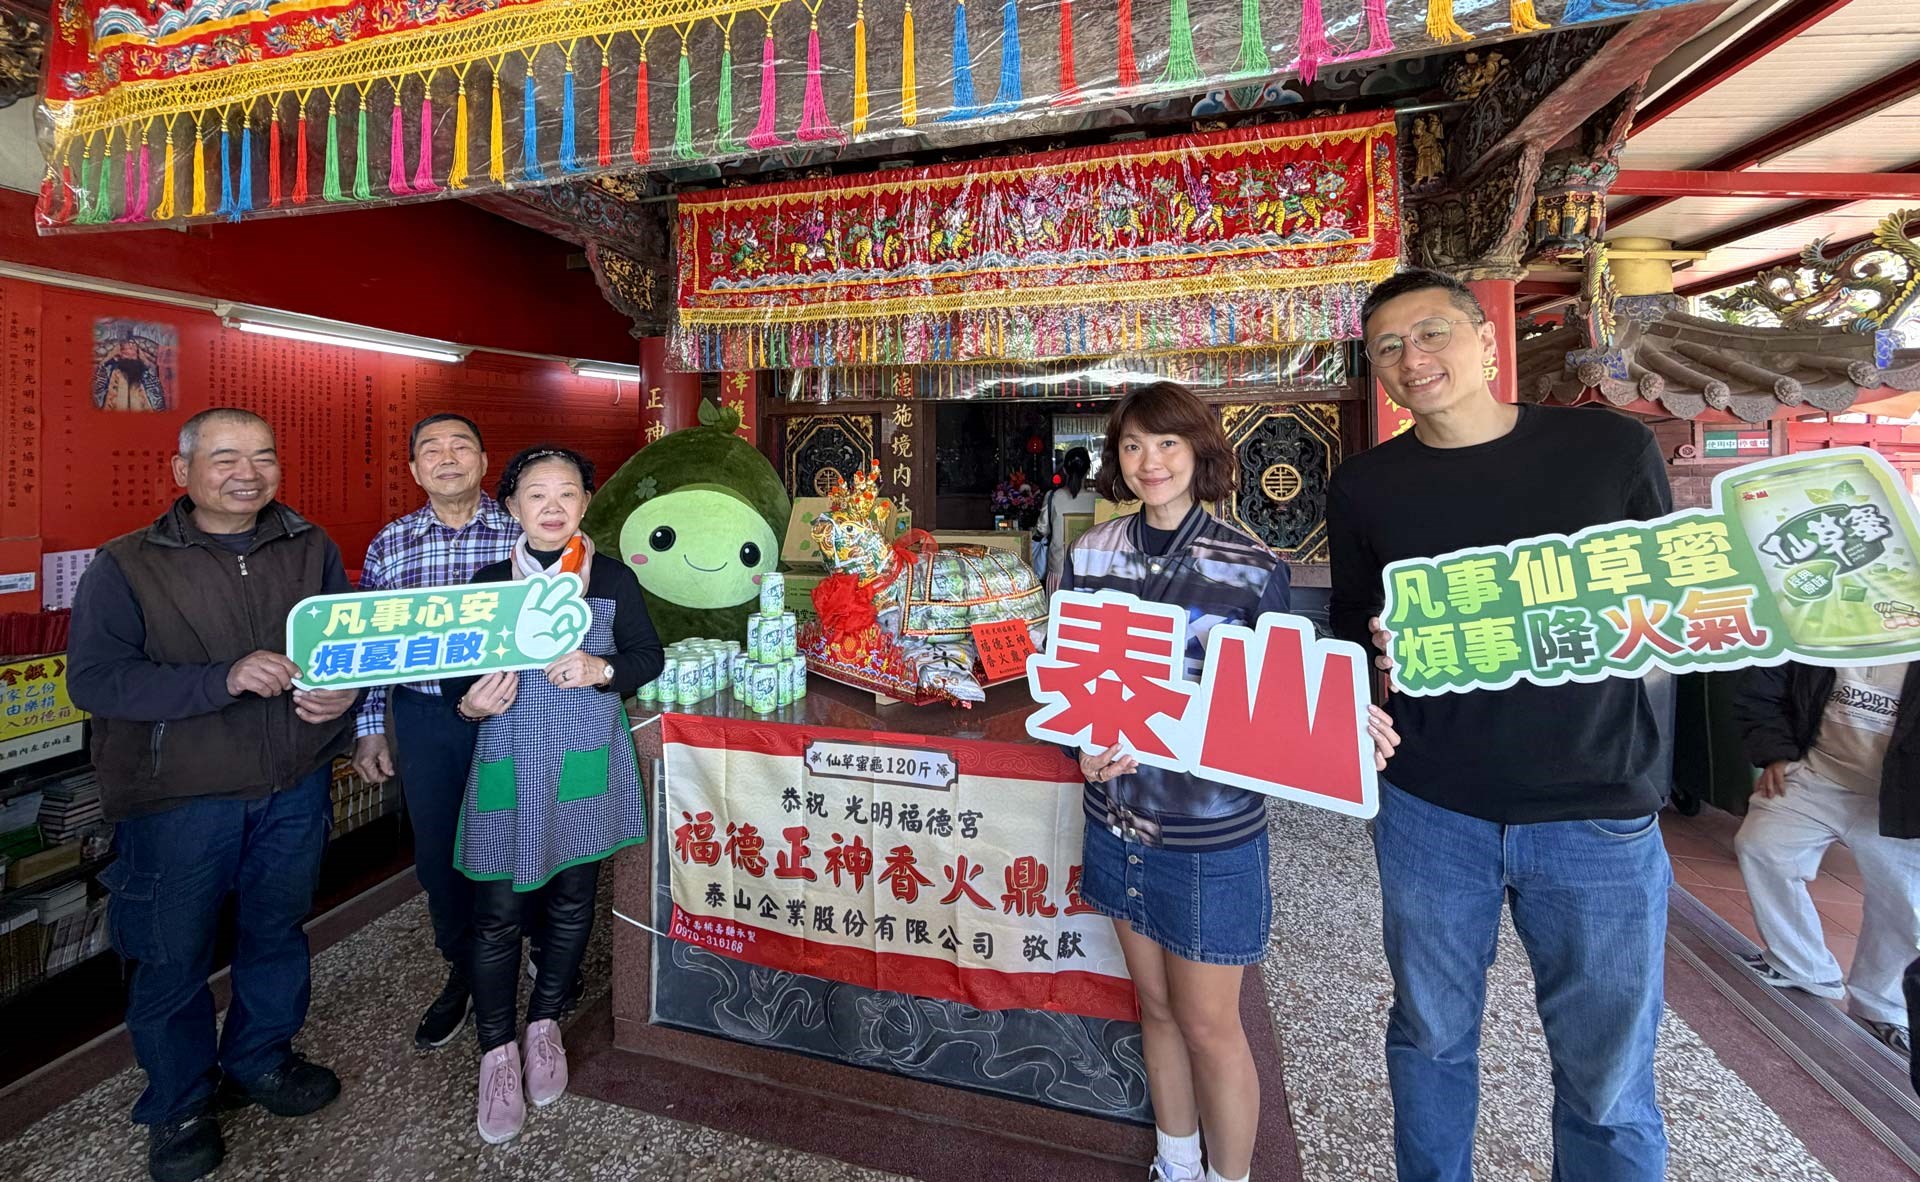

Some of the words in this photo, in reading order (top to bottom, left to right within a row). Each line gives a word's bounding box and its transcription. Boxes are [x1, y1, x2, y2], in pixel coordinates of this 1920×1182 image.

[645, 387, 666, 443] 正神
[1760, 506, 1890, 567] 仙草蜜
[1390, 519, 1740, 624] 凡事仙草蜜
[1788, 569, 1815, 588] 經典
[1801, 575, 1830, 595] 原味
[322, 591, 500, 637] 凡事心安
[1398, 586, 1768, 681] 煩事降火氣
[312, 630, 485, 678] 煩憂自散
[980, 633, 1026, 653] 福德正神
[1036, 601, 1364, 805] 泰山
[1842, 685, 1901, 711] SPORTS
[825, 749, 932, 779] 仙草蜜龜120斤
[781, 787, 829, 820] 恭祝
[844, 794, 984, 840] 光明福德宮
[704, 882, 995, 960] 泰山企業股份有限公司
[1022, 931, 1087, 962] 敬獻
